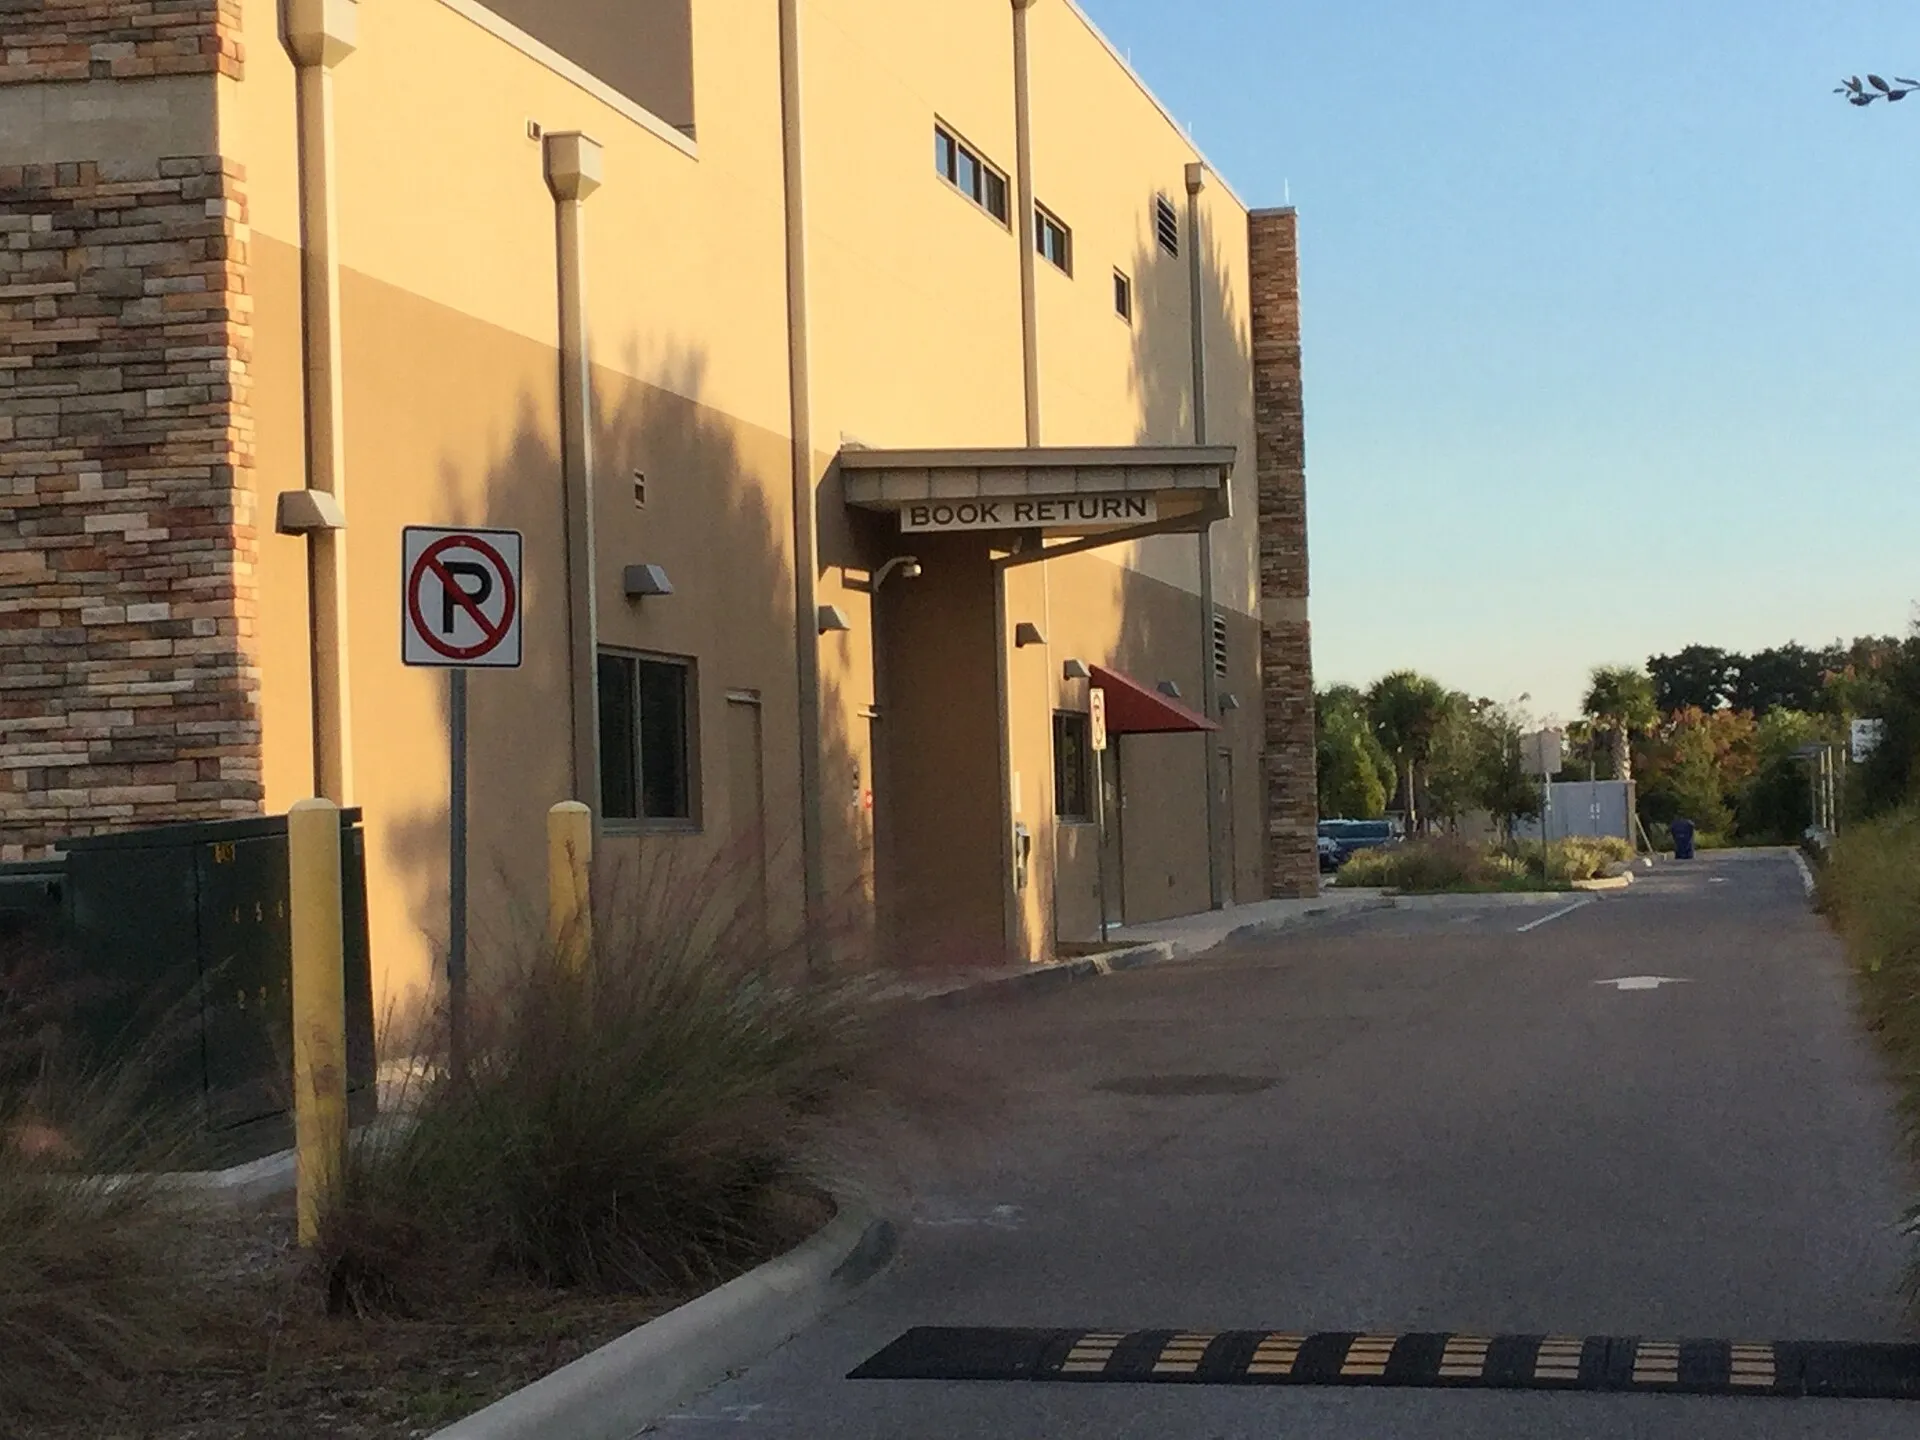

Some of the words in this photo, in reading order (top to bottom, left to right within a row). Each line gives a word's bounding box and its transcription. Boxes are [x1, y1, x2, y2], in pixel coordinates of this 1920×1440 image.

[911, 503, 1000, 526] BOOK
[1014, 497, 1147, 521] RETURN
[442, 561, 492, 634] P
